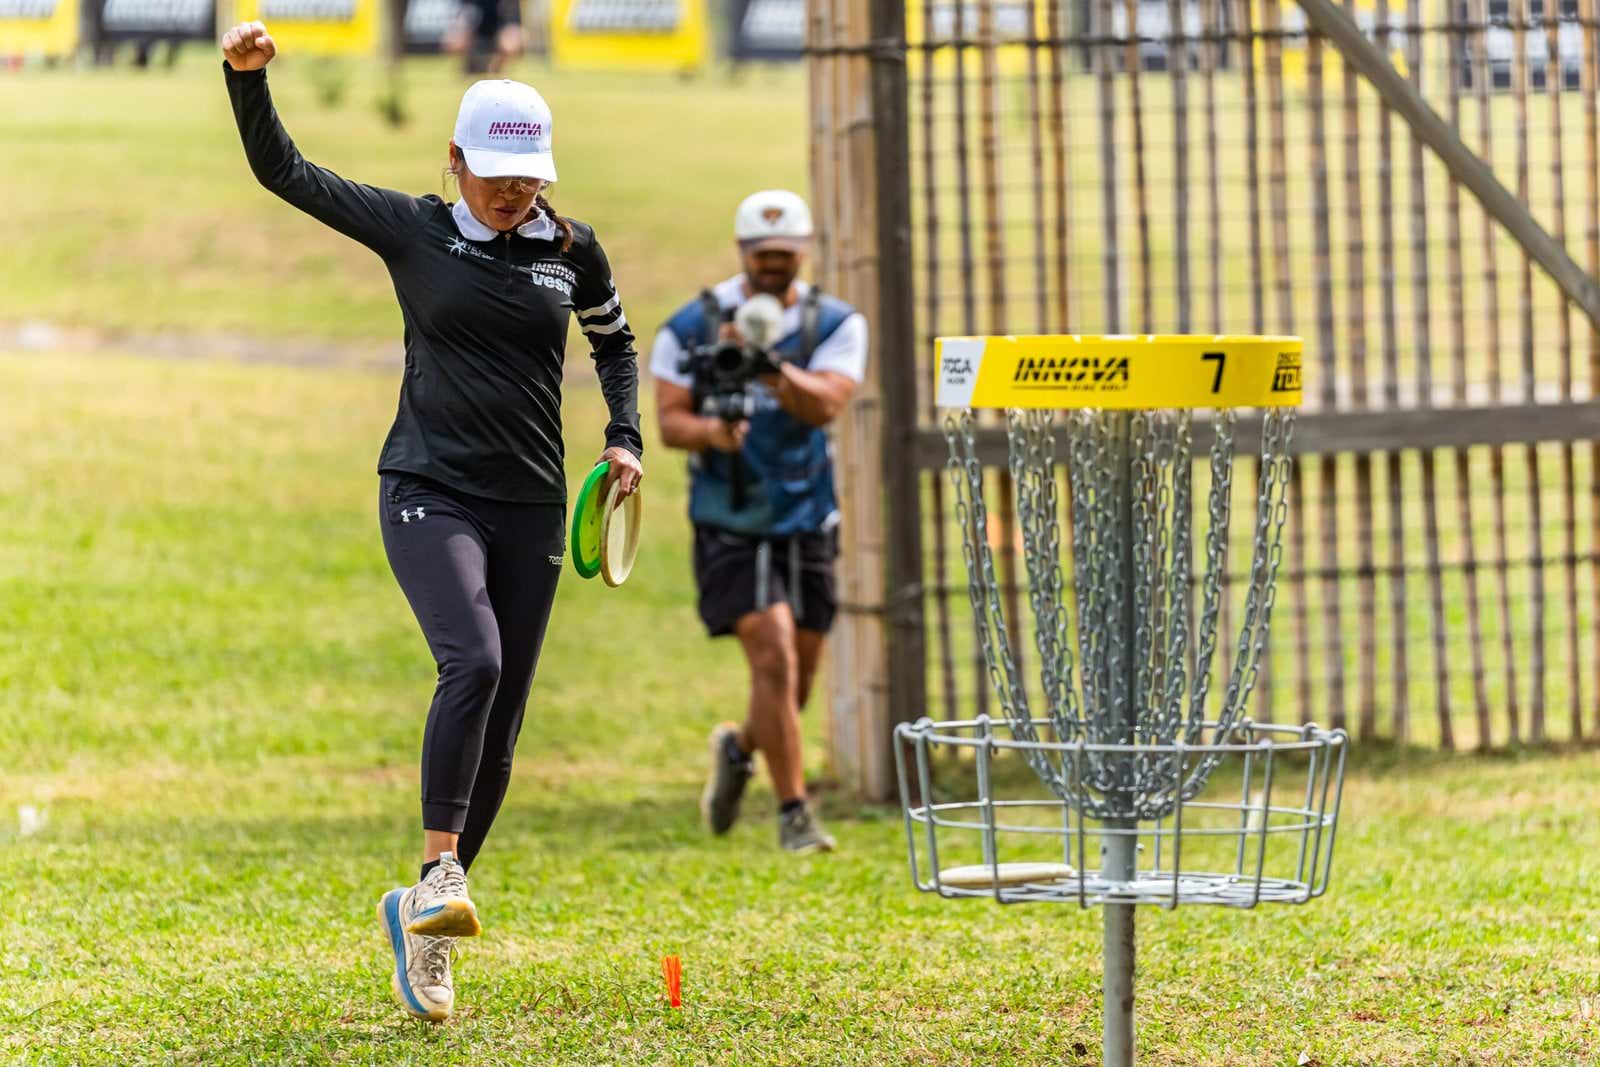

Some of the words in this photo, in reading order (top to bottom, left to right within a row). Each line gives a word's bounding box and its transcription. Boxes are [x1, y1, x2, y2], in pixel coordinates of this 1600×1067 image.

[488, 121, 542, 136] INNOVA
[531, 262, 577, 286] INNOVA
[1014, 357, 1131, 381] INNOVA
[1201, 352, 1226, 393] 7
